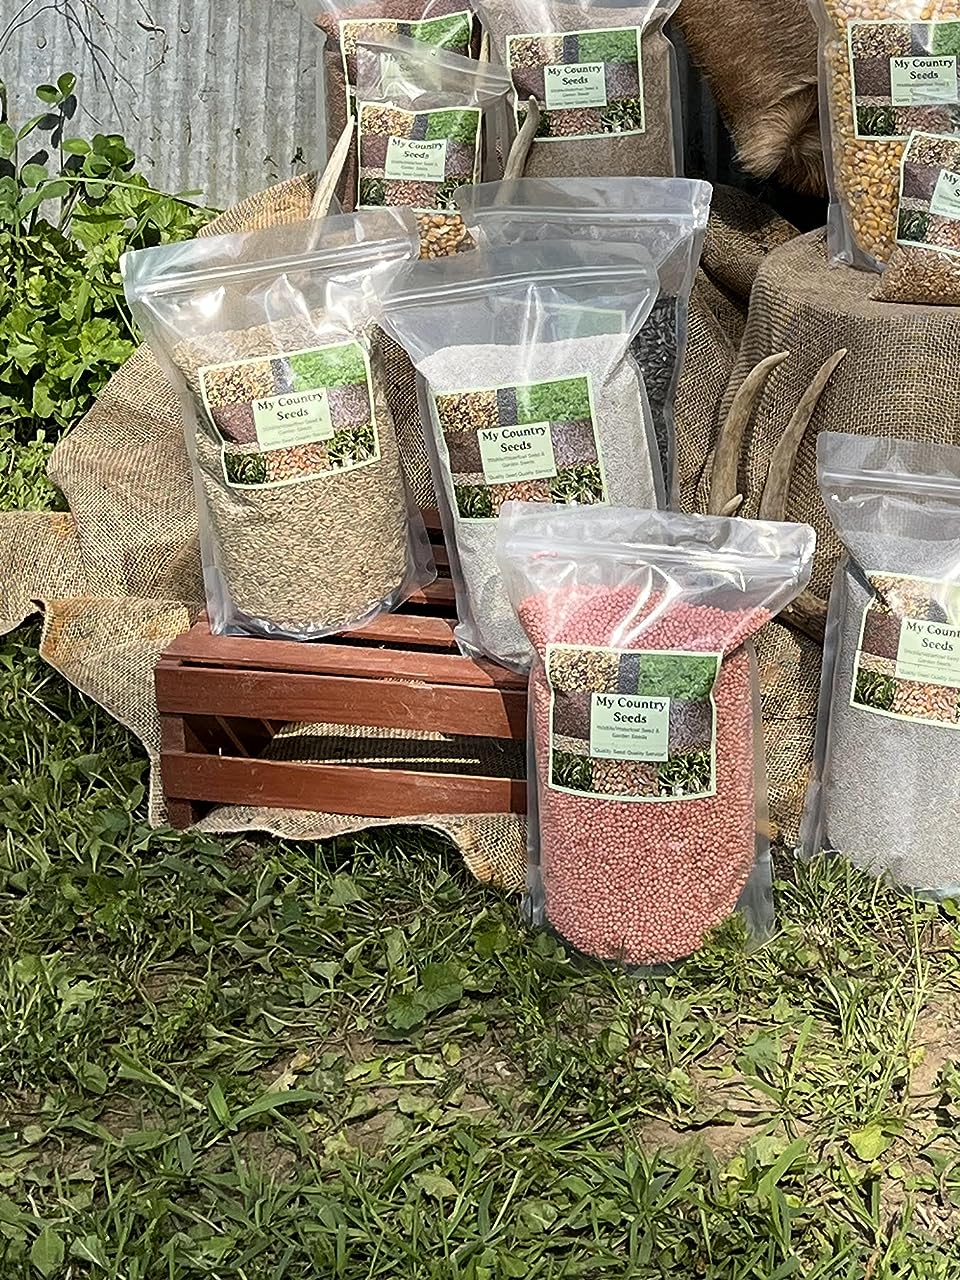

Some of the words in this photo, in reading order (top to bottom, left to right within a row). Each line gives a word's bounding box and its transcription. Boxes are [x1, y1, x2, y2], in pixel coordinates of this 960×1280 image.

[894, 60, 910, 69] My
[912, 59, 954, 68] Country
[910, 70, 939, 80] Seeds
[943, 172, 959, 185] My
[258, 401, 274, 411] My
[278, 393, 323, 407] Country
[277, 408, 309, 421] Seeds
[482, 431, 499, 442] My
[502, 426, 547, 439] Country
[500, 441, 532, 453] Seeds
[906, 621, 924, 634] My
[922, 638, 954, 651] Seeds
[596, 696, 615, 709] My
[618, 697, 666, 712] Country
[613, 711, 647, 724] Seeds
